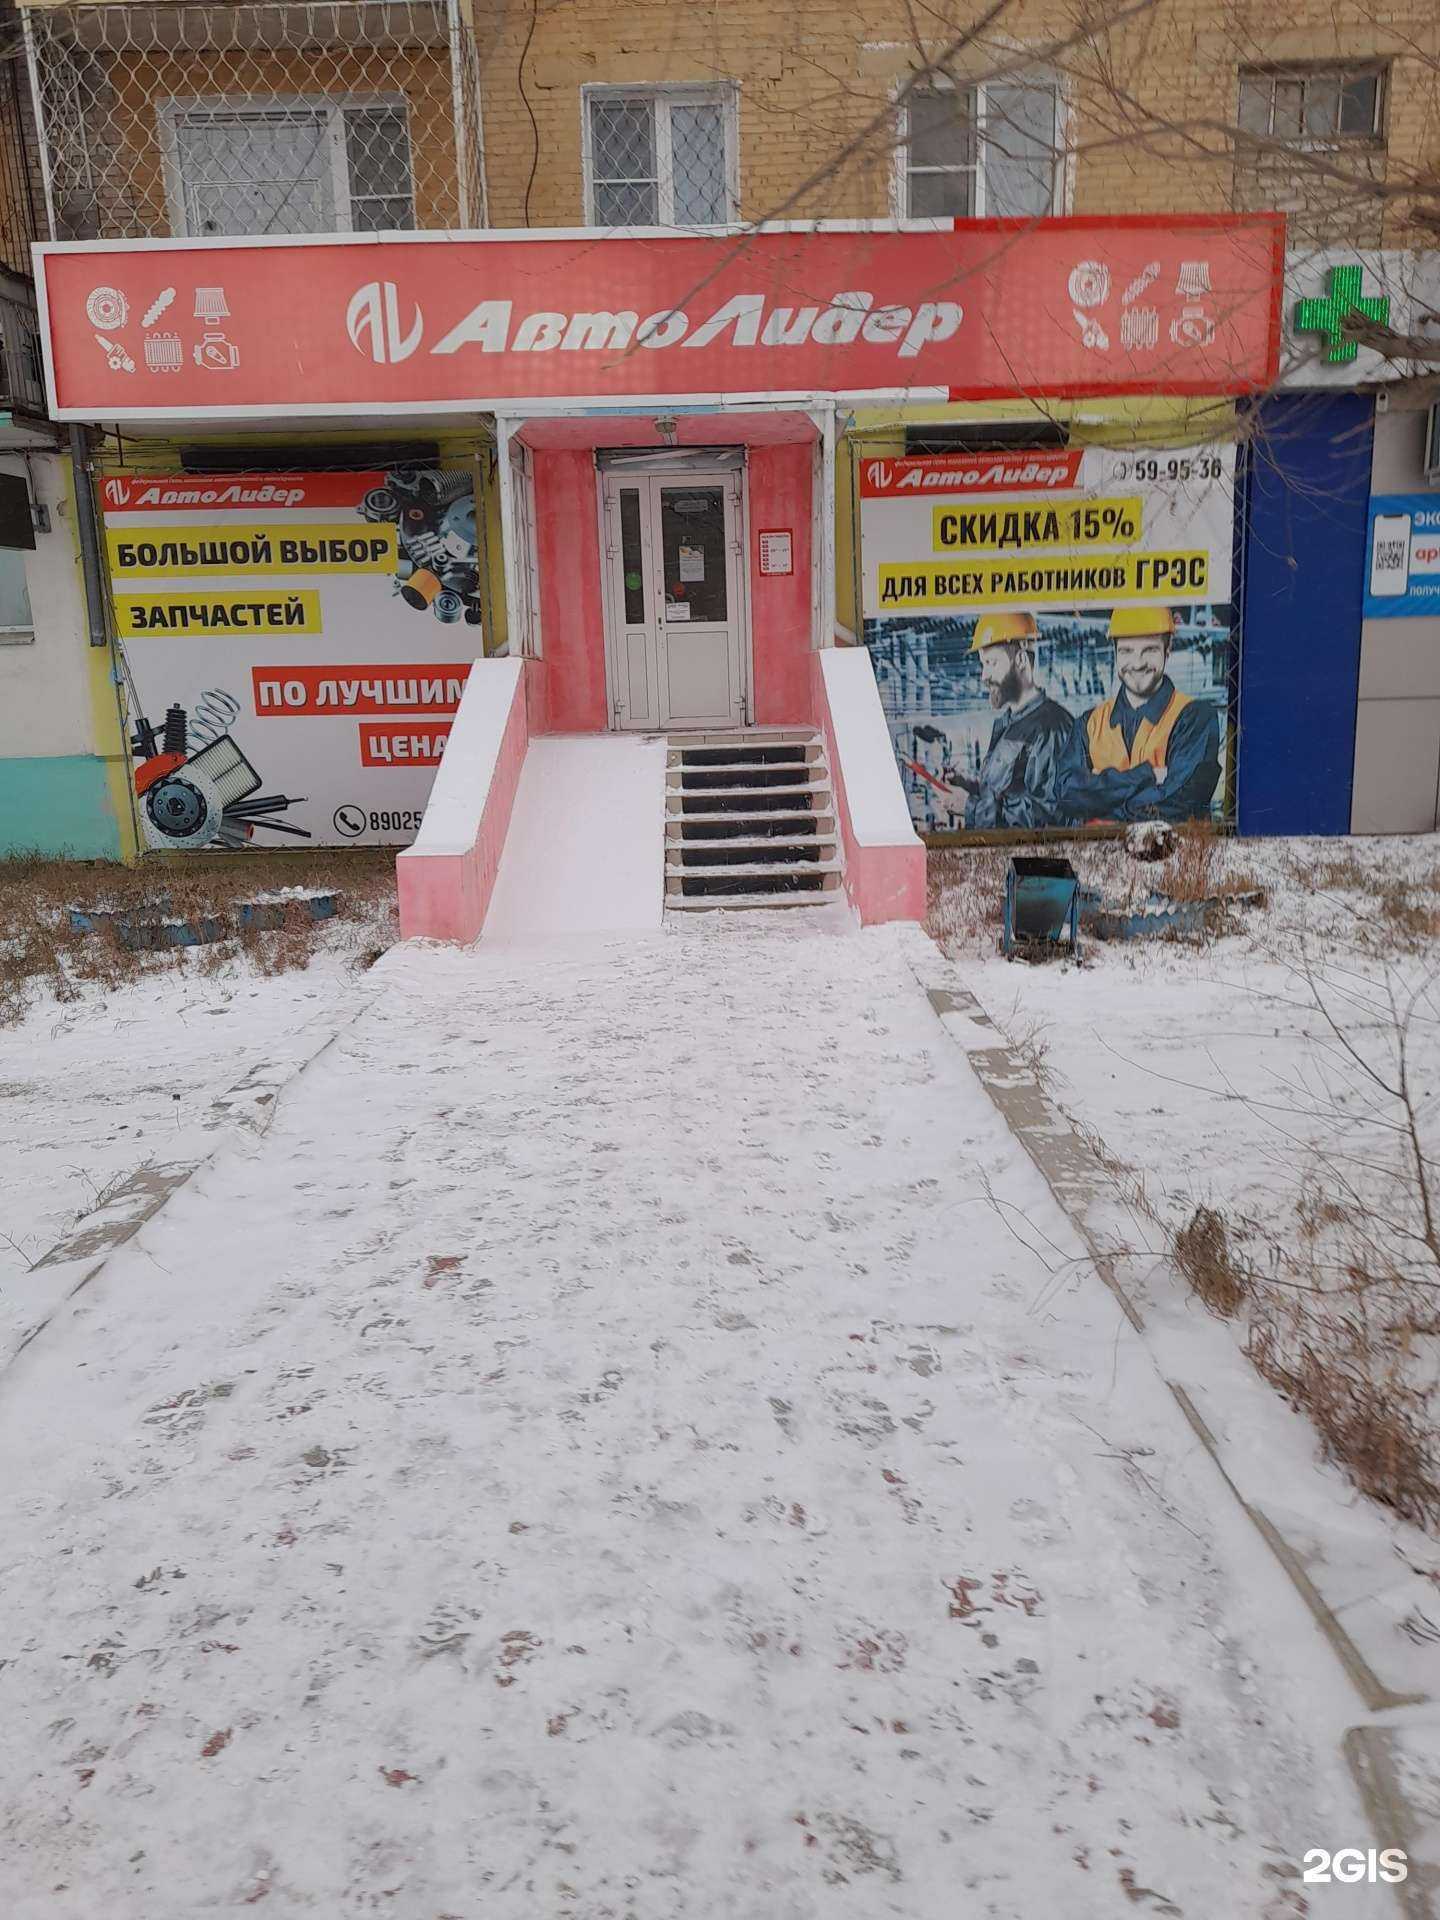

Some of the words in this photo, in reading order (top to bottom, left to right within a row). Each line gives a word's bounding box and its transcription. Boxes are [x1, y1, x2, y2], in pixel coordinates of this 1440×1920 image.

[430, 290, 965, 358] АвтоЛидер
[896, 462, 1069, 487] АвтоЛидер
[135, 485, 305, 506] АвтоЛидер
[940, 509, 1059, 549] СКИДКА
[1069, 507, 1135, 539] 15%
[117, 533, 273, 567] БОЛЬШОЙ
[280, 538, 389, 564] ВЫБОР
[882, 575, 927, 602] ДЛЯ
[934, 573, 984, 596] ВСЕХ
[991, 565, 1126, 594] РАБОТНИКОВ
[1135, 557, 1206, 590] ГРЭС
[130, 596, 305, 630] ЗАПЧАСТЕЙ
[259, 680, 307, 707] ПО
